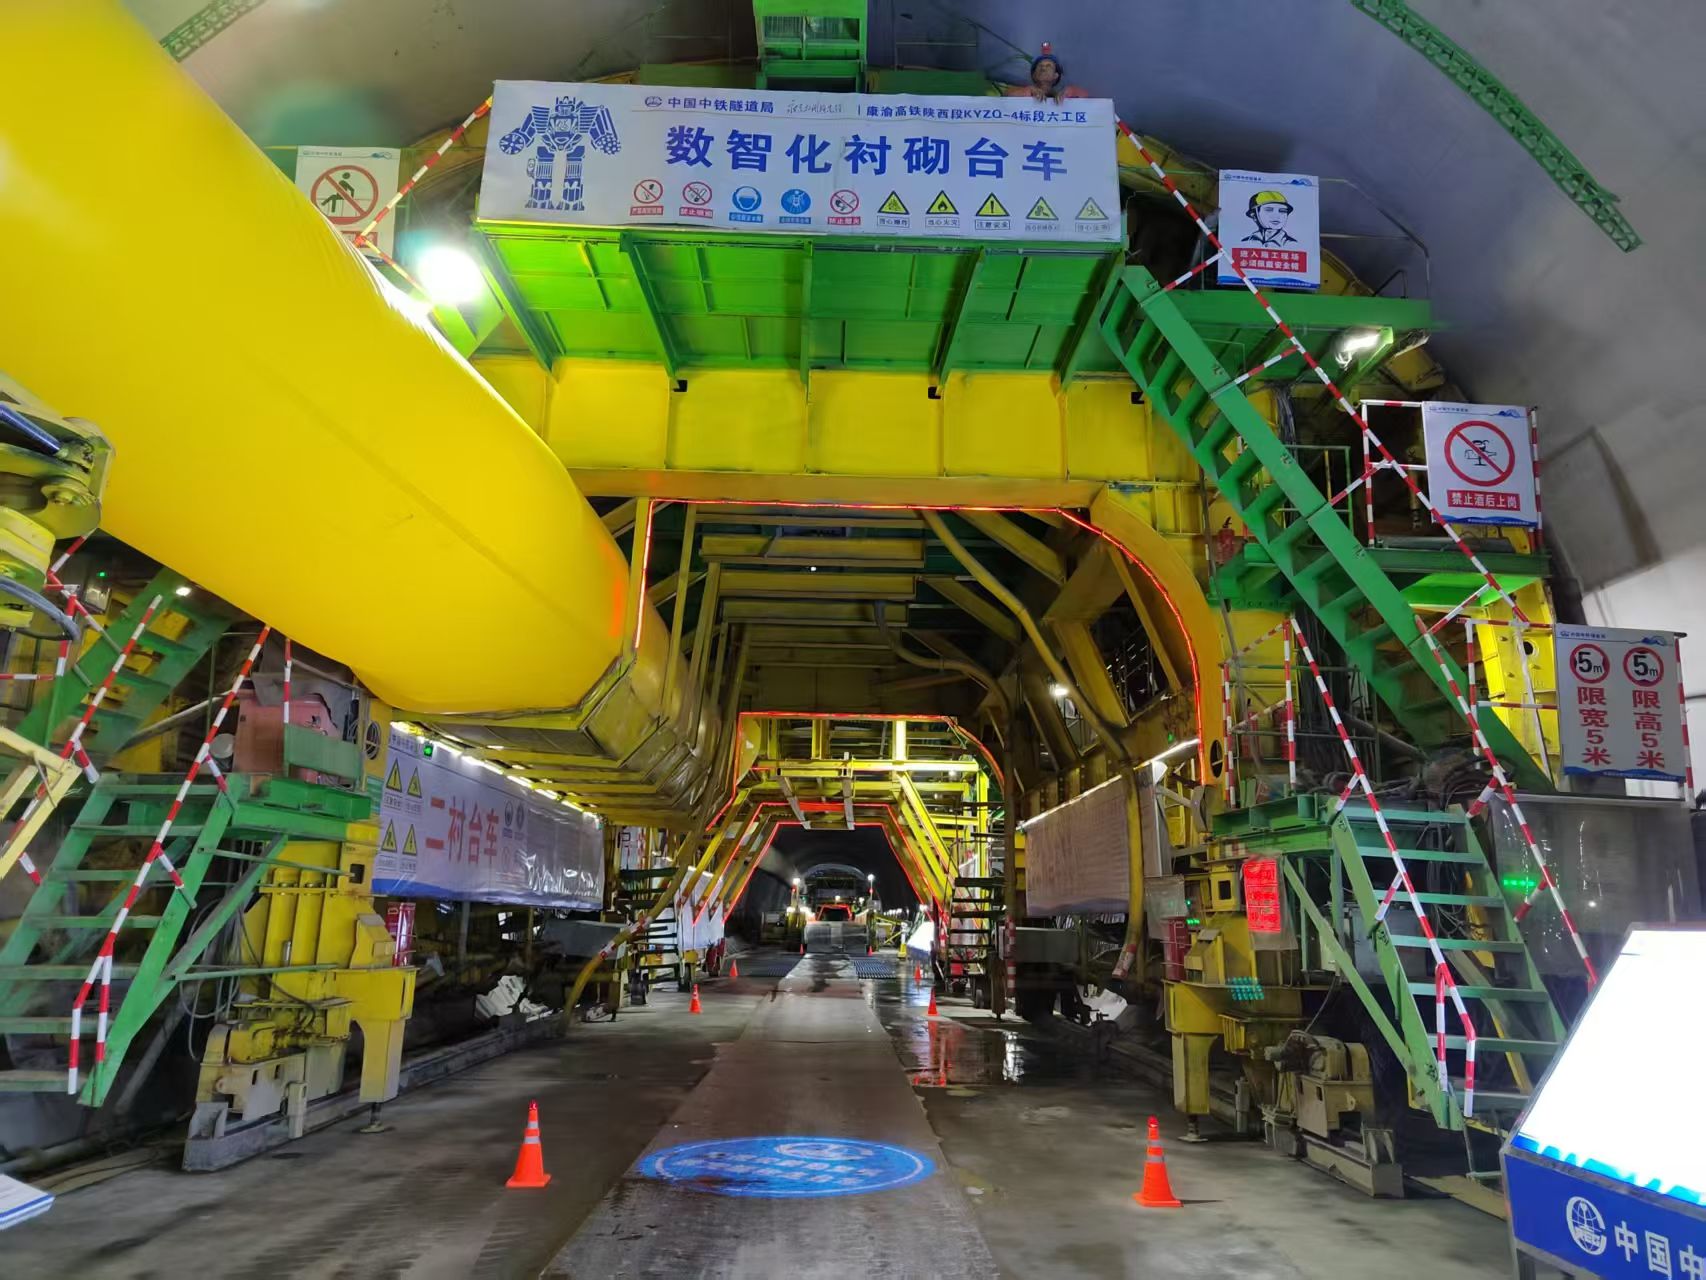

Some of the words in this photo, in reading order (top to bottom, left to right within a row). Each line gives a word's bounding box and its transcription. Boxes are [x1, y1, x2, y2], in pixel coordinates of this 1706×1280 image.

[667, 96, 774, 114] 中国中铁隧道局
[866, 104, 1088, 124] 康渝高铁陕西段KYZQ-4标段六工区
[665, 124, 1068, 182] 数智化衬砌台车
[1239, 250, 1300, 261] 进入施工现场
[1239, 259, 1300, 271] 必须佩戴安全帽
[1451, 492, 1517, 509] 禁止酒后上岗
[1577, 686, 1611, 767] 限宽5米
[1631, 689, 1665, 769] 限高5米
[425, 794, 501, 865] 二衬台车
